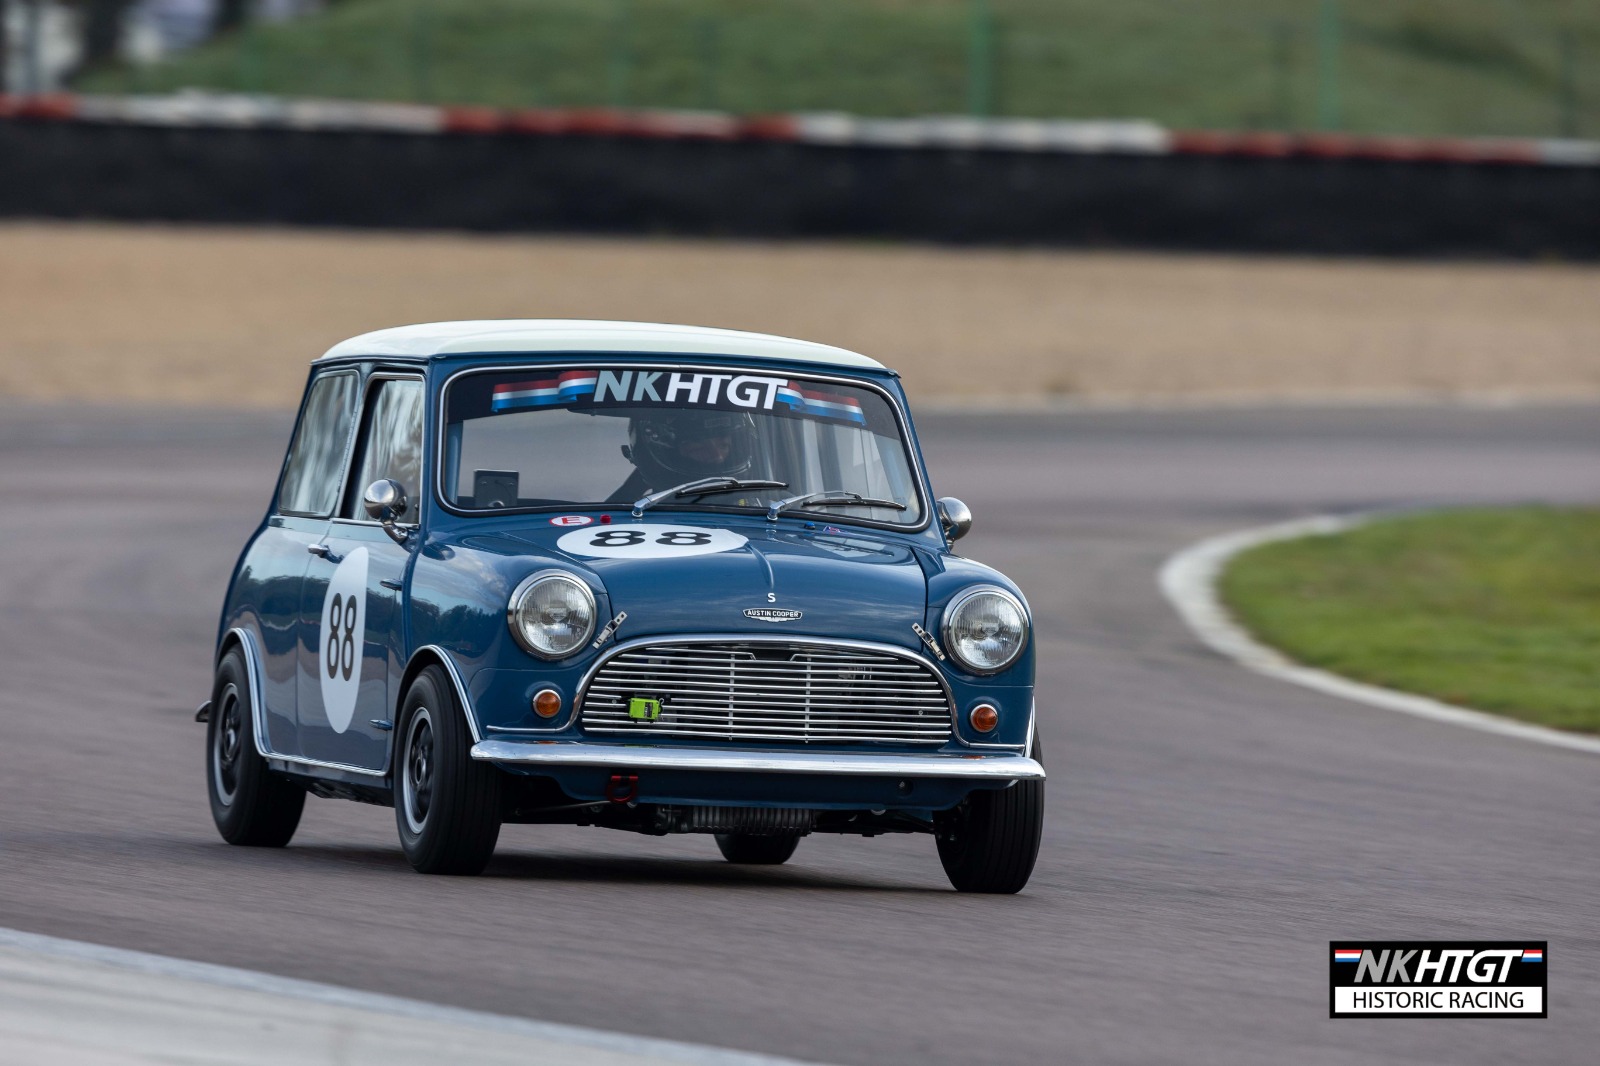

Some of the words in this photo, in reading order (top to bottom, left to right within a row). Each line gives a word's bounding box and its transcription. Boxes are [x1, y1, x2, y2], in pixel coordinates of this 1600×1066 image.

[593, 370, 788, 410] NKHTGT
[561, 516, 583, 525] E
[589, 530, 713, 547] 88
[767, 592, 776, 603] S
[327, 592, 357, 682] 88
